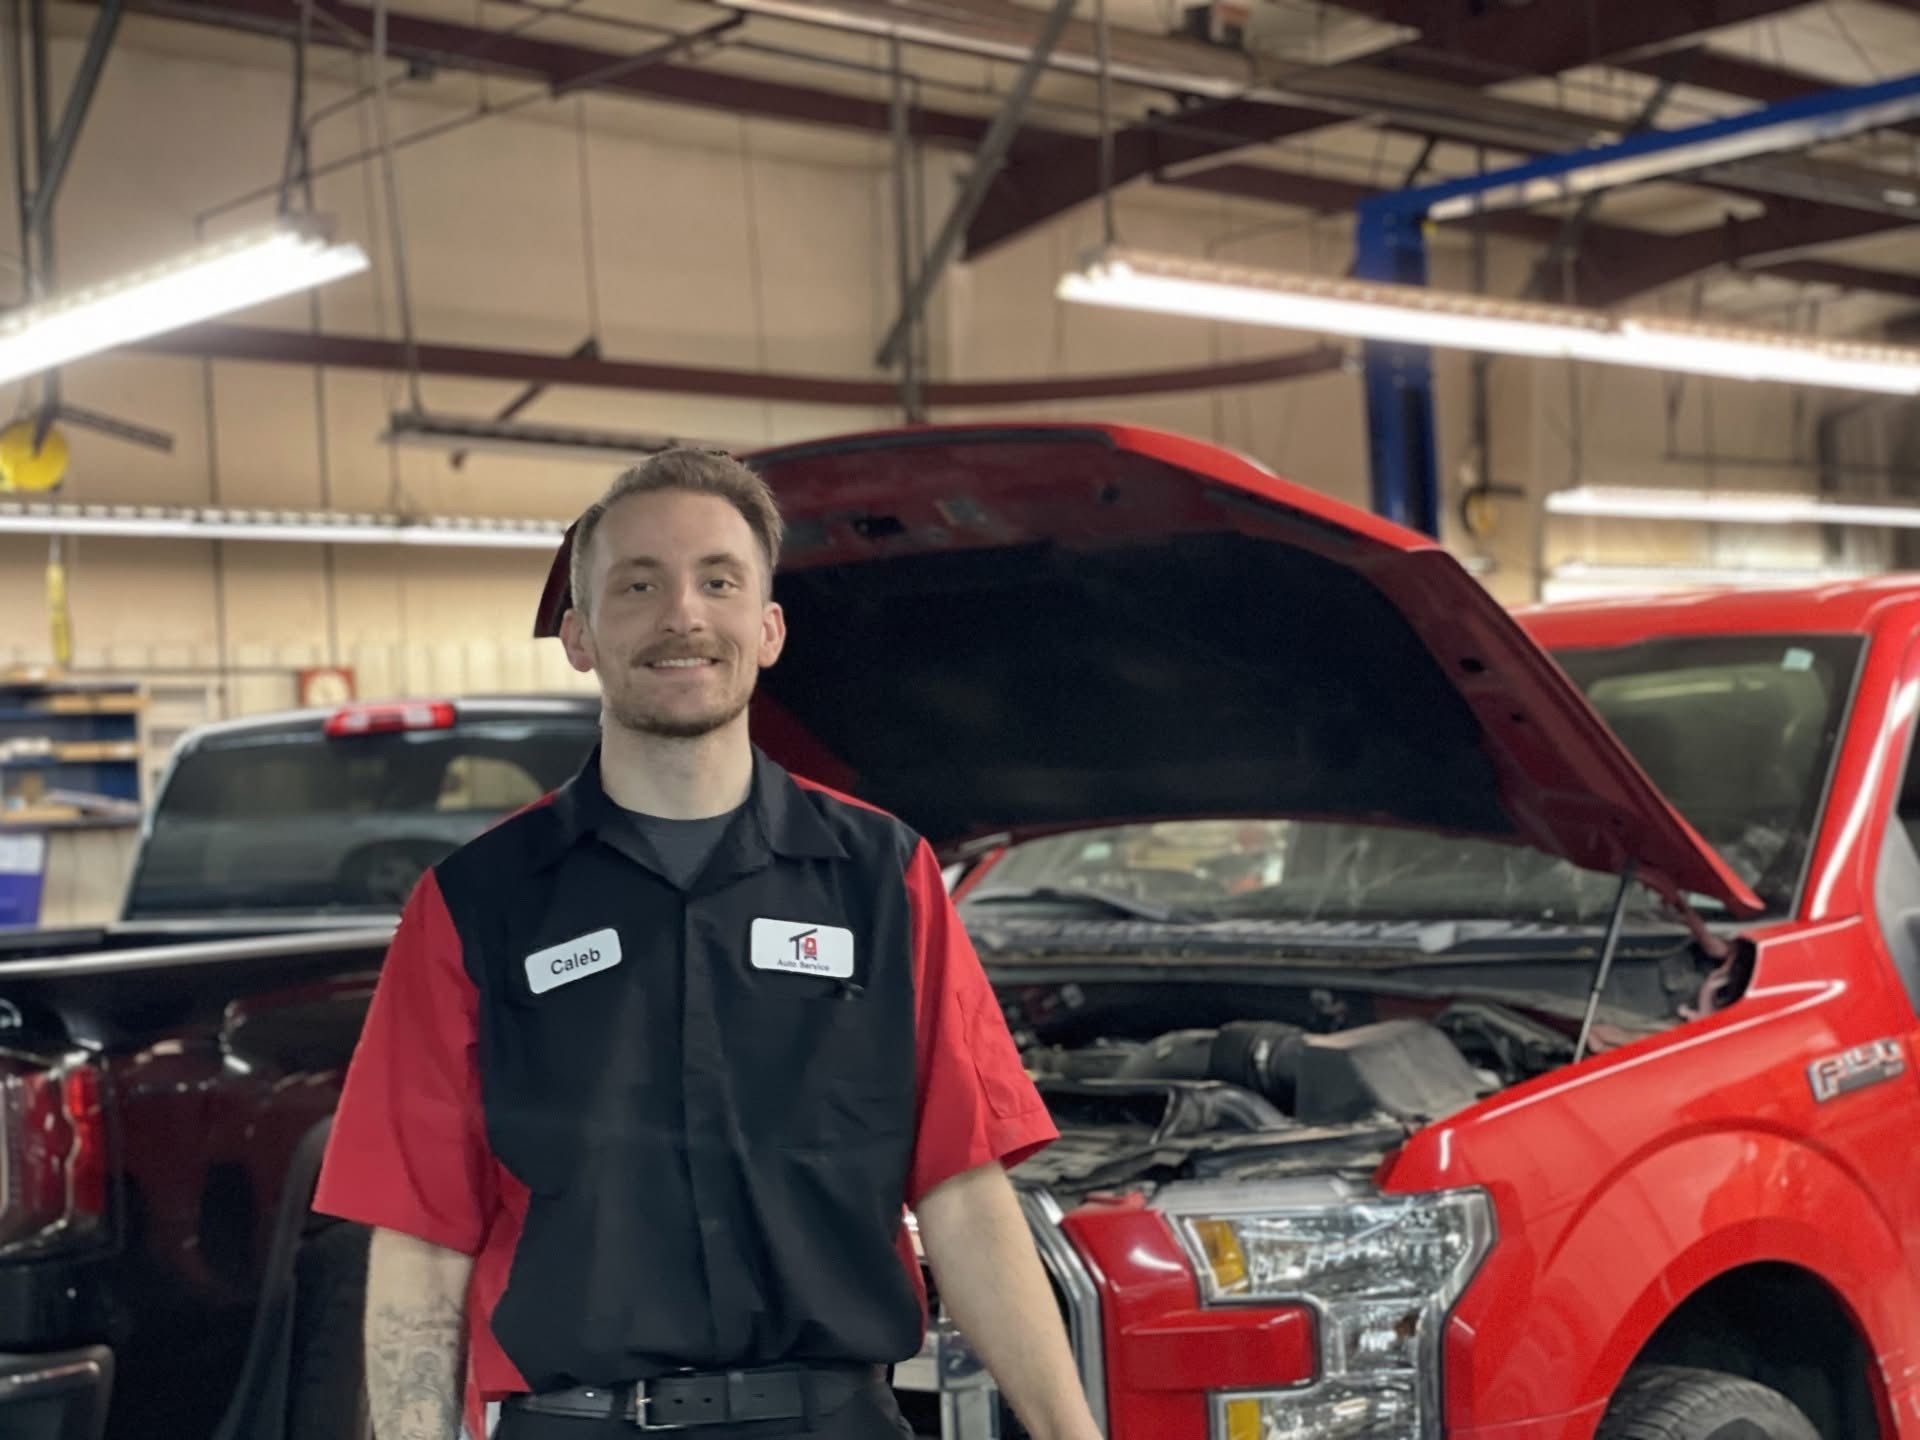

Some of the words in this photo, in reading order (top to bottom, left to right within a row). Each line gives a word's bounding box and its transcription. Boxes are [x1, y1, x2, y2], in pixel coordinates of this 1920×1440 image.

[550, 947, 601, 975] Caleb
[777, 958, 797, 969] Auto
[799, 961, 830, 972] Service
